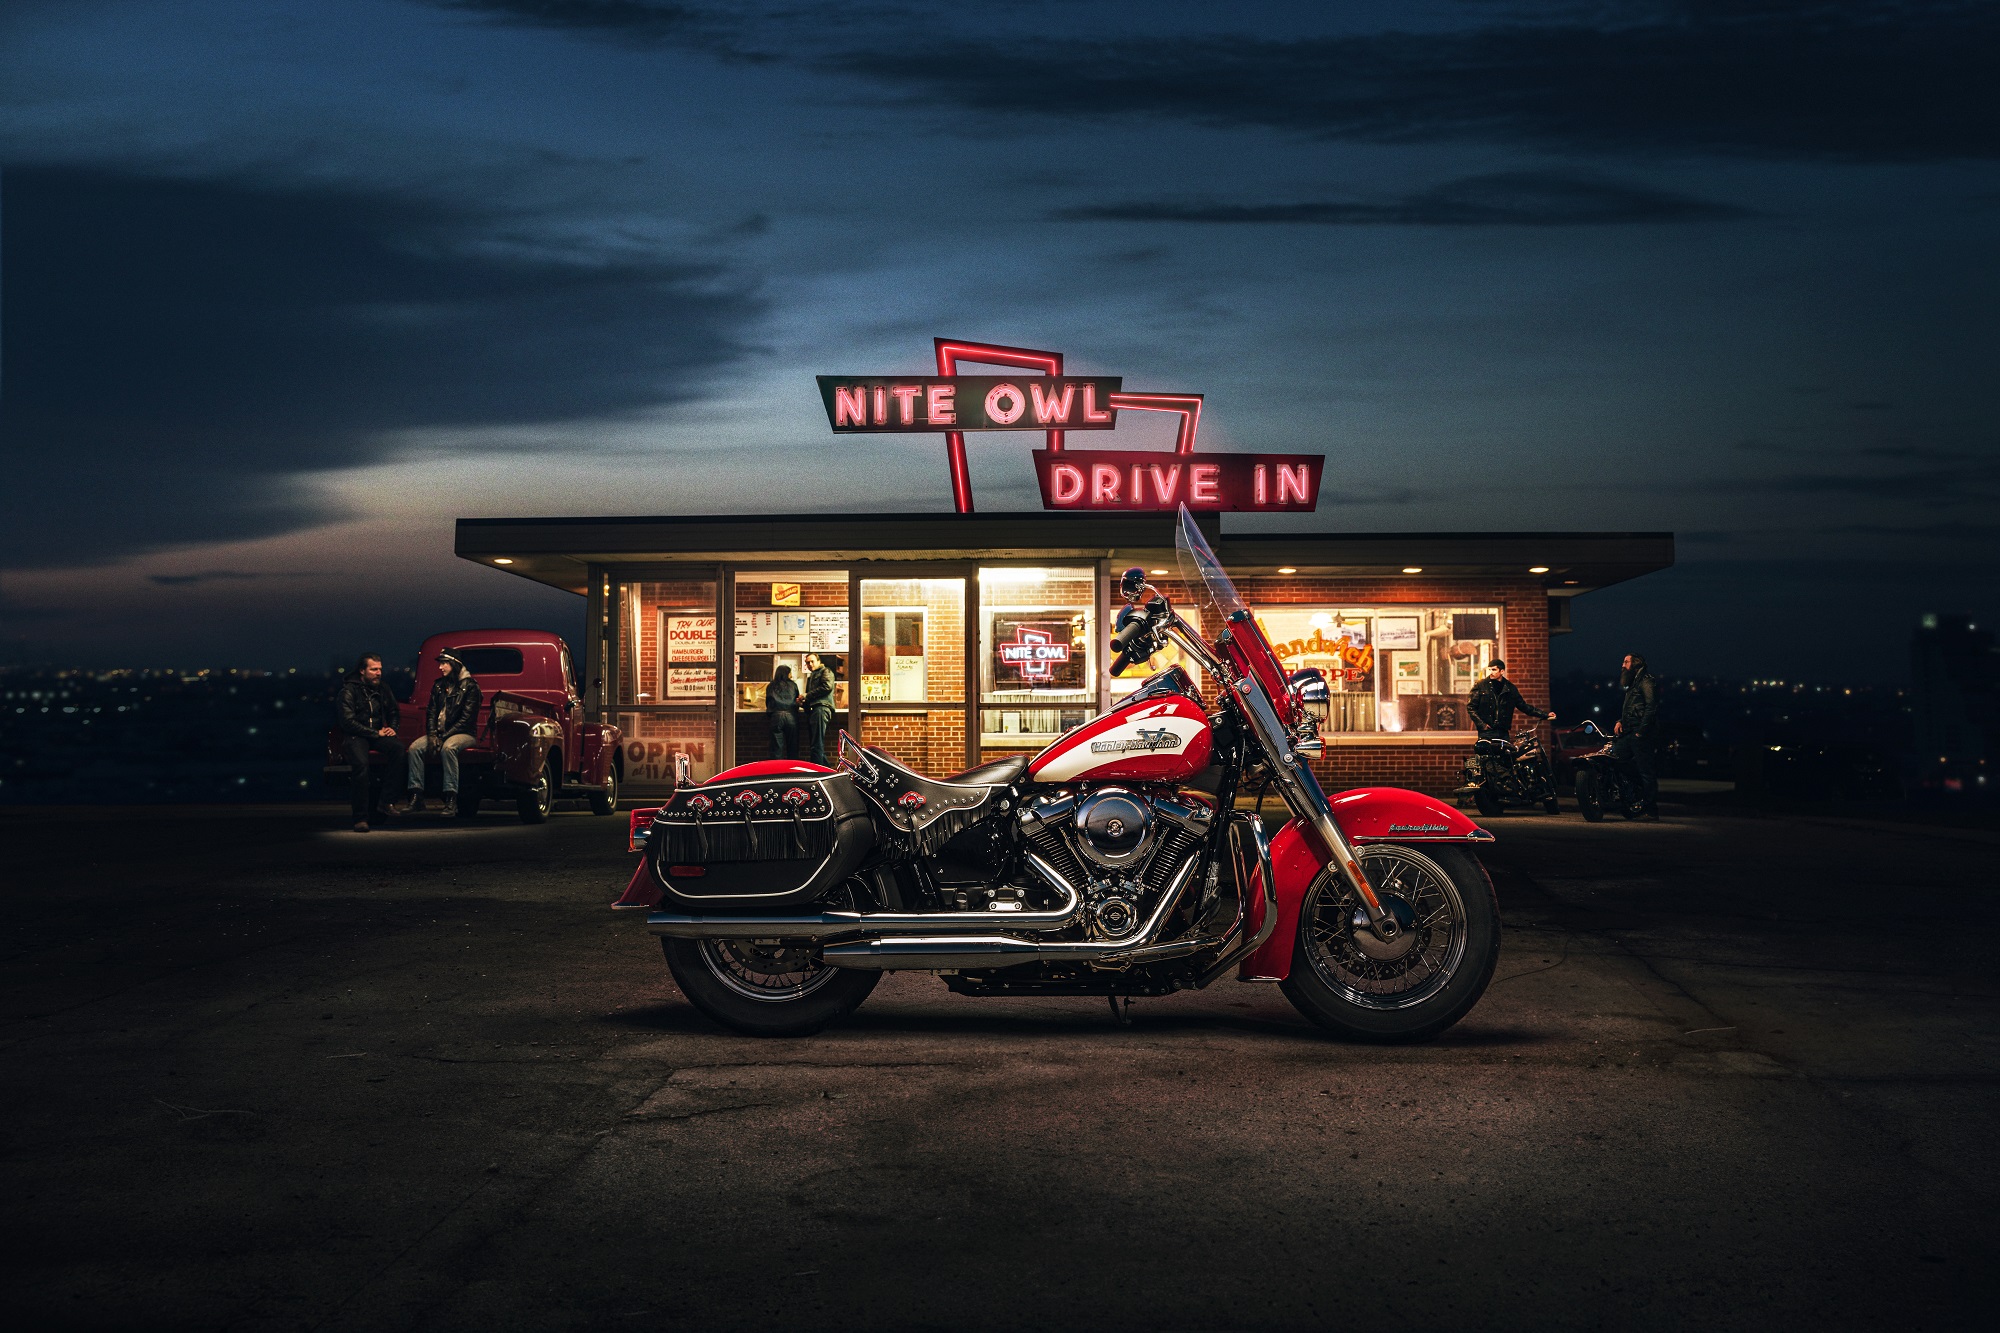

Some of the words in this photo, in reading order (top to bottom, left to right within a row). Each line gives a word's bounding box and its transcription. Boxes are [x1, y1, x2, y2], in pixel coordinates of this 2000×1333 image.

[835, 384, 957, 426] NITE
[985, 383, 1112, 424] OWL
[1051, 463, 1221, 504] DRIVE
[1254, 463, 1309, 504] IN
[676, 620, 693, 630] TRY
[695, 618, 716, 627] OUR
[670, 630, 716, 640] DOUBLES
[1005, 646, 1032, 659] NITE
[1036, 646, 1066, 659] OWL
[1272, 628, 1374, 673] andwich
[627, 741, 704, 763] OPEN
[631, 764, 645, 777] at
[646, 764, 691, 780] 11A
